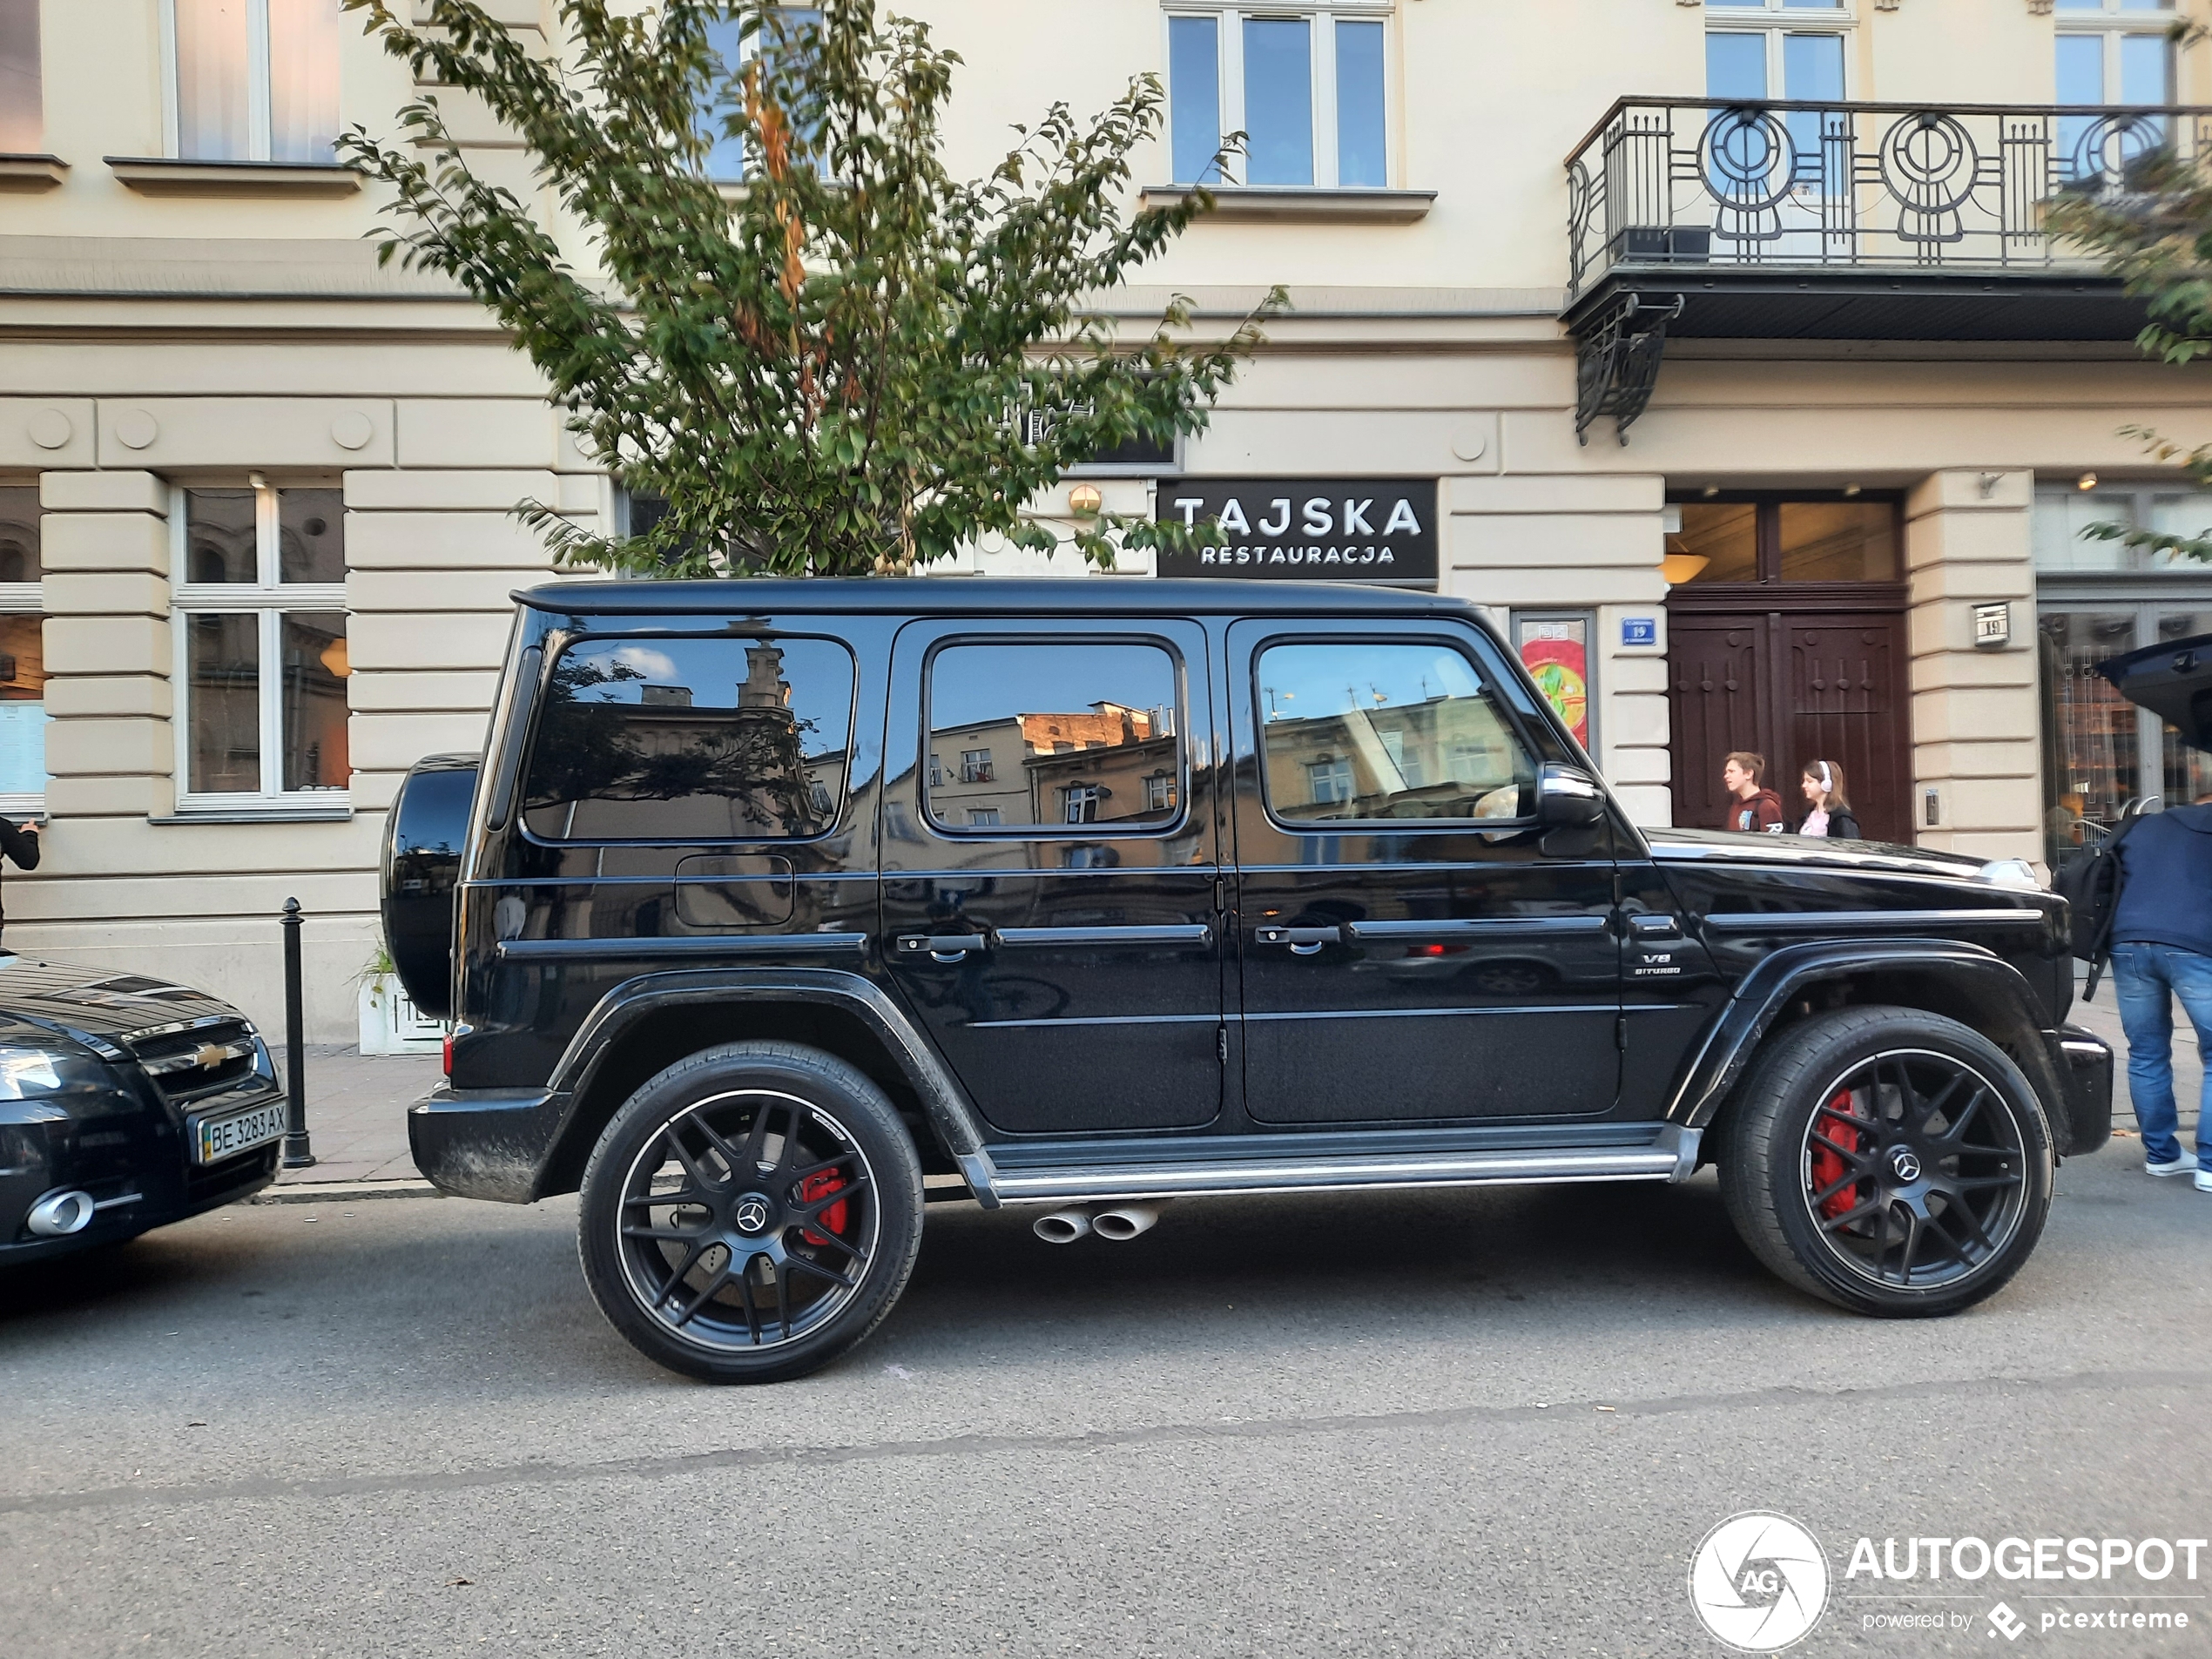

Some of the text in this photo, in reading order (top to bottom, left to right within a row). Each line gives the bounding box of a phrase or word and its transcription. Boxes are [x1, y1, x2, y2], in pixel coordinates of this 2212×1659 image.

[1174, 497, 1422, 537] TAJSKA
[1201, 545, 1396, 564] RESTAURACJA
[1633, 625, 1647, 637] 19
[1986, 621, 2000, 635] 19
[1642, 954, 1671, 963] V8
[212, 1107, 286, 1152] BE 3283 AX
